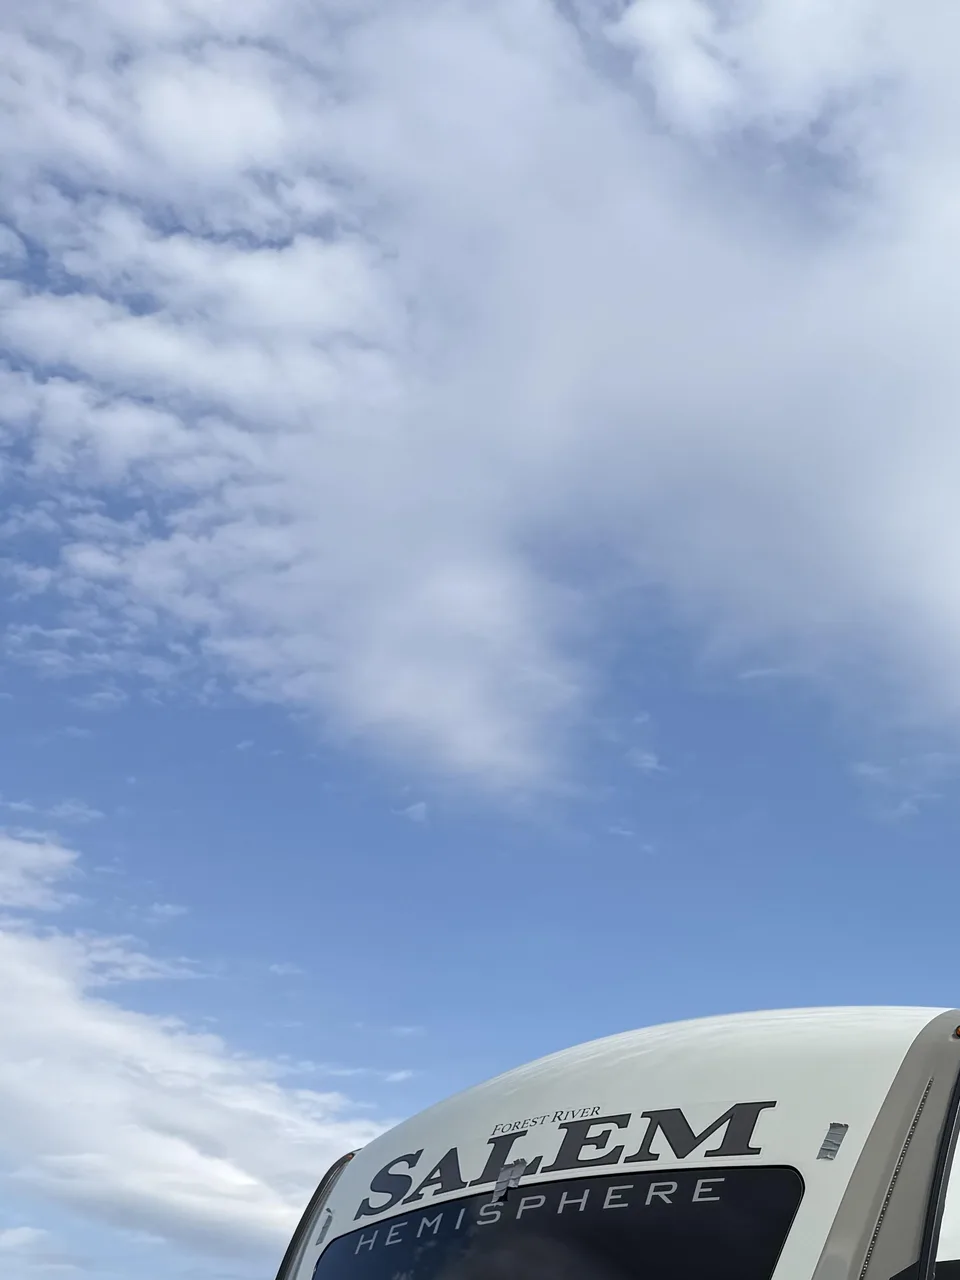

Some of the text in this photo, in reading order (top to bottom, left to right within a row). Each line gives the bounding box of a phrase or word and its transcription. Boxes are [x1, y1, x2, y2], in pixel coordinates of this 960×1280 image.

[491, 1106, 601, 1136] FOREST RIVER
[354, 1101, 777, 1221] SALEM
[355, 1177, 726, 1255] HEMISPHERE
